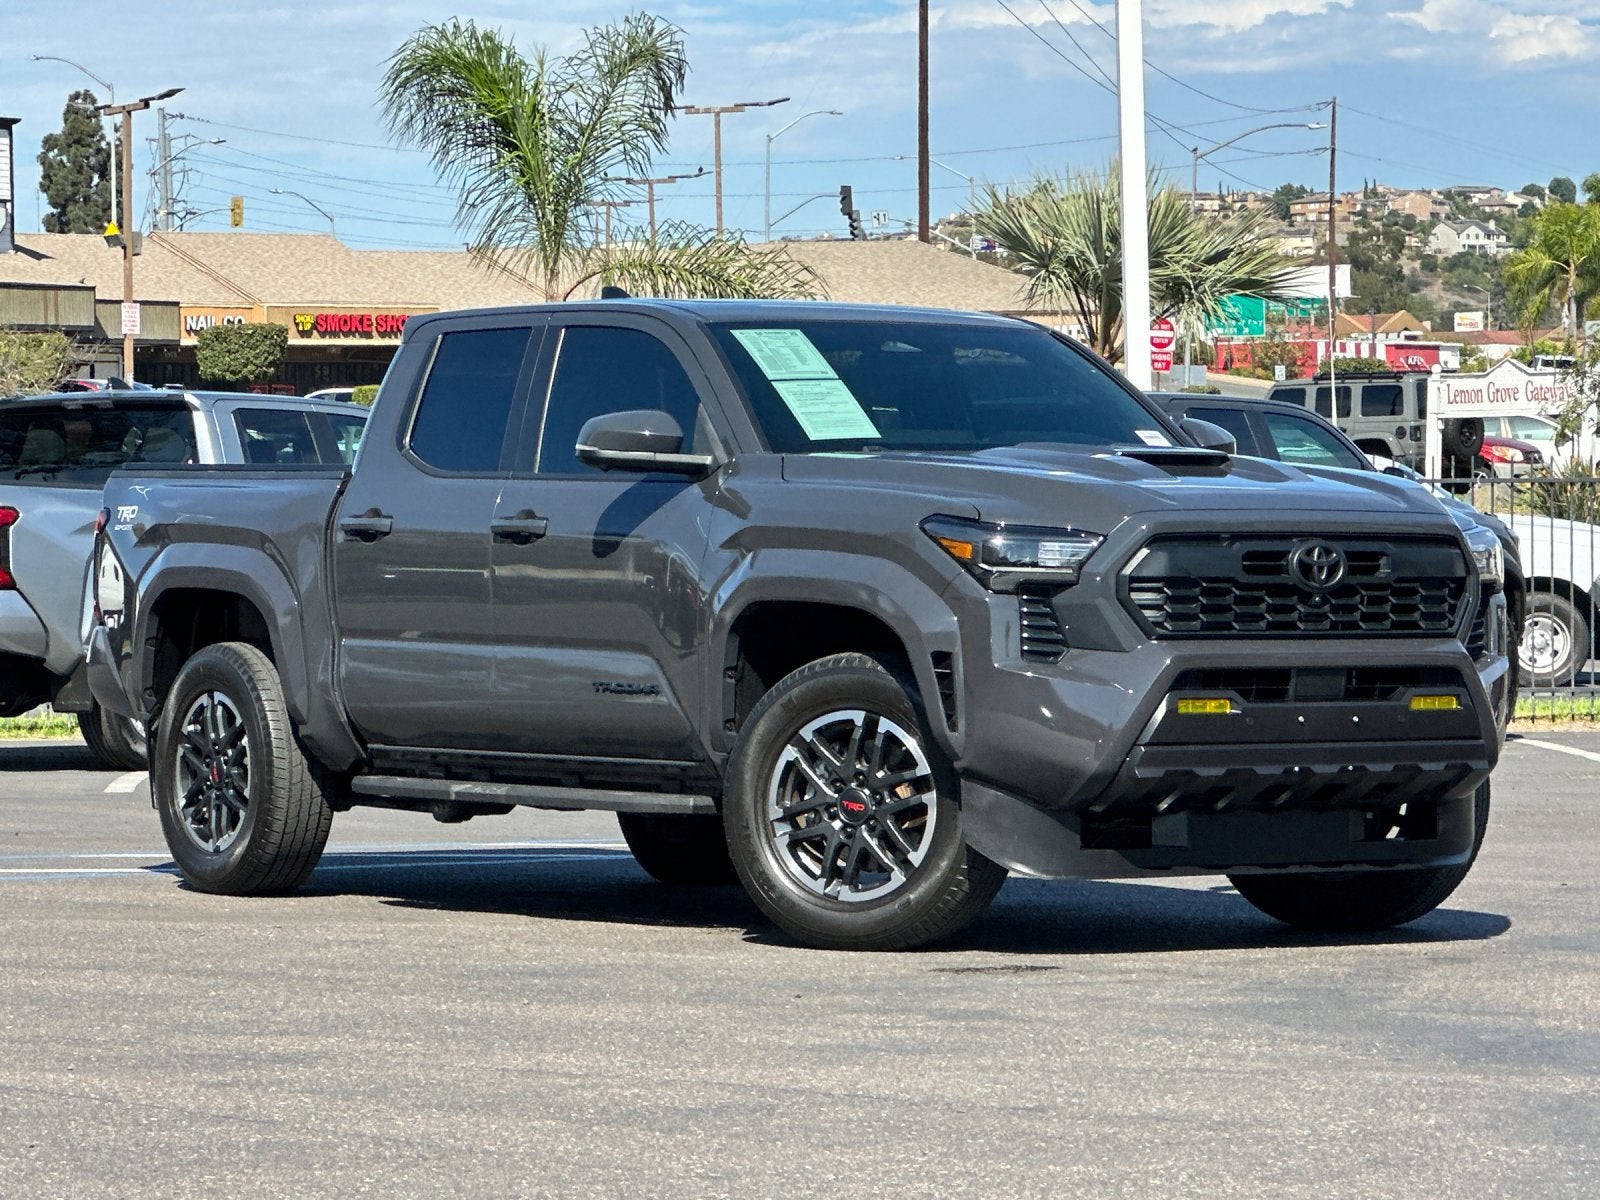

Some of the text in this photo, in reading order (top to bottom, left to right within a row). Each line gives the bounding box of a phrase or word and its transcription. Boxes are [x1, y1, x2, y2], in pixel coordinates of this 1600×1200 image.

[316, 314, 408, 332] SMOKE SHO
[1153, 361, 1167, 369] WAY
[1408, 356, 1422, 365] KFC
[1446, 383, 1484, 405] Lemon
[1487, 381, 1519, 403] Grove
[117, 505, 139, 522] TRD
[842, 800, 865, 811] TRD
